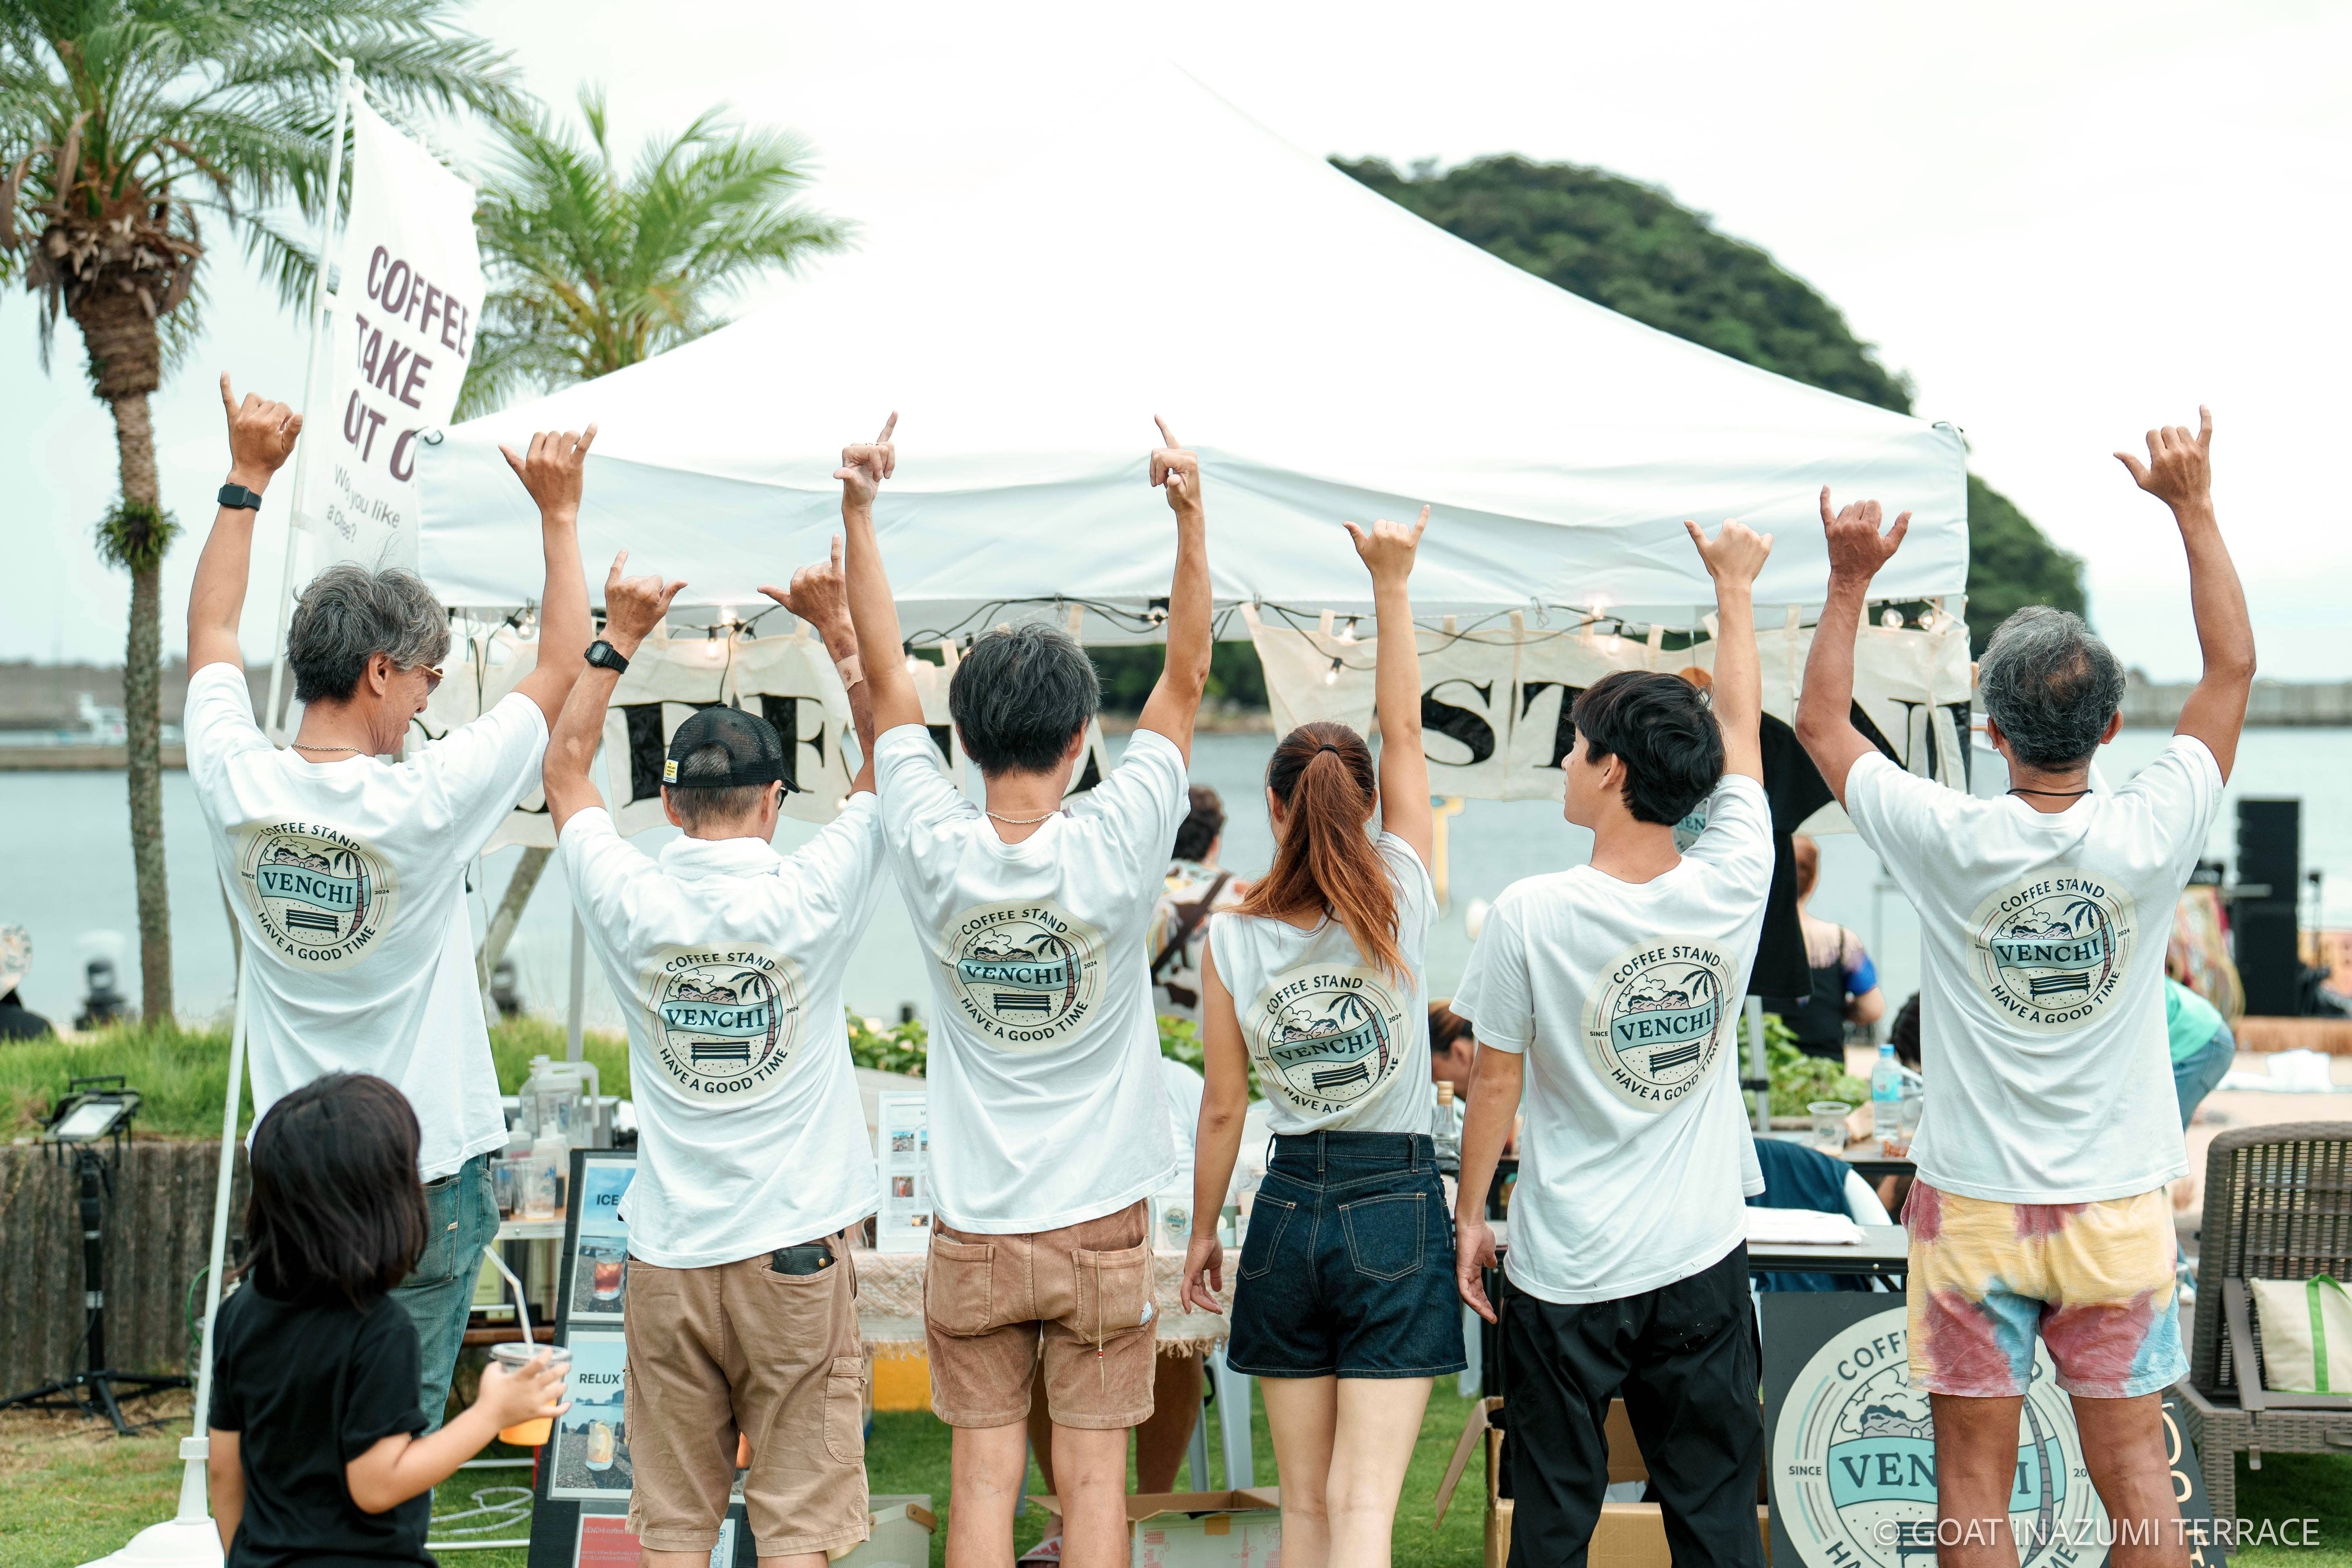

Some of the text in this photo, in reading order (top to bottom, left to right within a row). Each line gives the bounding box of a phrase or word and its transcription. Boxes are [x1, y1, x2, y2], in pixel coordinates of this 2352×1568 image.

[367, 244, 470, 359] COFFEE
[356, 312, 433, 409] TAKE
[327, 504, 335, 521] a
[349, 490, 369, 510] you
[371, 499, 401, 529] like
[261, 822, 360, 851] COFFEE STAND
[241, 871, 255, 880] SINCE
[262, 871, 353, 904] VENCHI
[2000, 878, 2105, 913] COFFEE STAND
[961, 908, 1068, 935] COFFEE STAND
[2117, 927, 2131, 938] 2024
[258, 912, 376, 961] HAVE A GOOD TIME
[1975, 943, 1991, 952] SINCE
[1996, 938, 2100, 963] VENCHI
[666, 952, 776, 973] COFFEE STAND
[940, 960, 955, 969] SINCE
[964, 964, 1063, 984] VENCHI
[1083, 960, 1098, 969] 2024
[1613, 945, 1721, 985] COFFEE STAND
[1266, 974, 1363, 1015] COFFEE STAND
[1990, 970, 2121, 1024] HAVE A GOOD TIME
[665, 1008, 765, 1029] VENCHI
[786, 1005, 799, 1014] 2024
[960, 998, 1089, 1042] HAVE A GOOD TIME
[1388, 1012, 1402, 1024] 2024
[1617, 1007, 1712, 1042] VENCHI
[1275, 1028, 1373, 1061] VENCHI
[659, 1048, 788, 1094] HAVE A GOOD TIME
[1611, 1039, 1720, 1101] HAVE A GOOD TIME
[1283, 1086, 1319, 1111] HAVE
[1322, 1103, 1333, 1114] A
[596, 1194, 620, 1206] ICE
[1837, 1329, 1908, 1382] COFF
[579, 1373, 620, 1384] RELUX
[1789, 1465, 1822, 1476] SINCE
